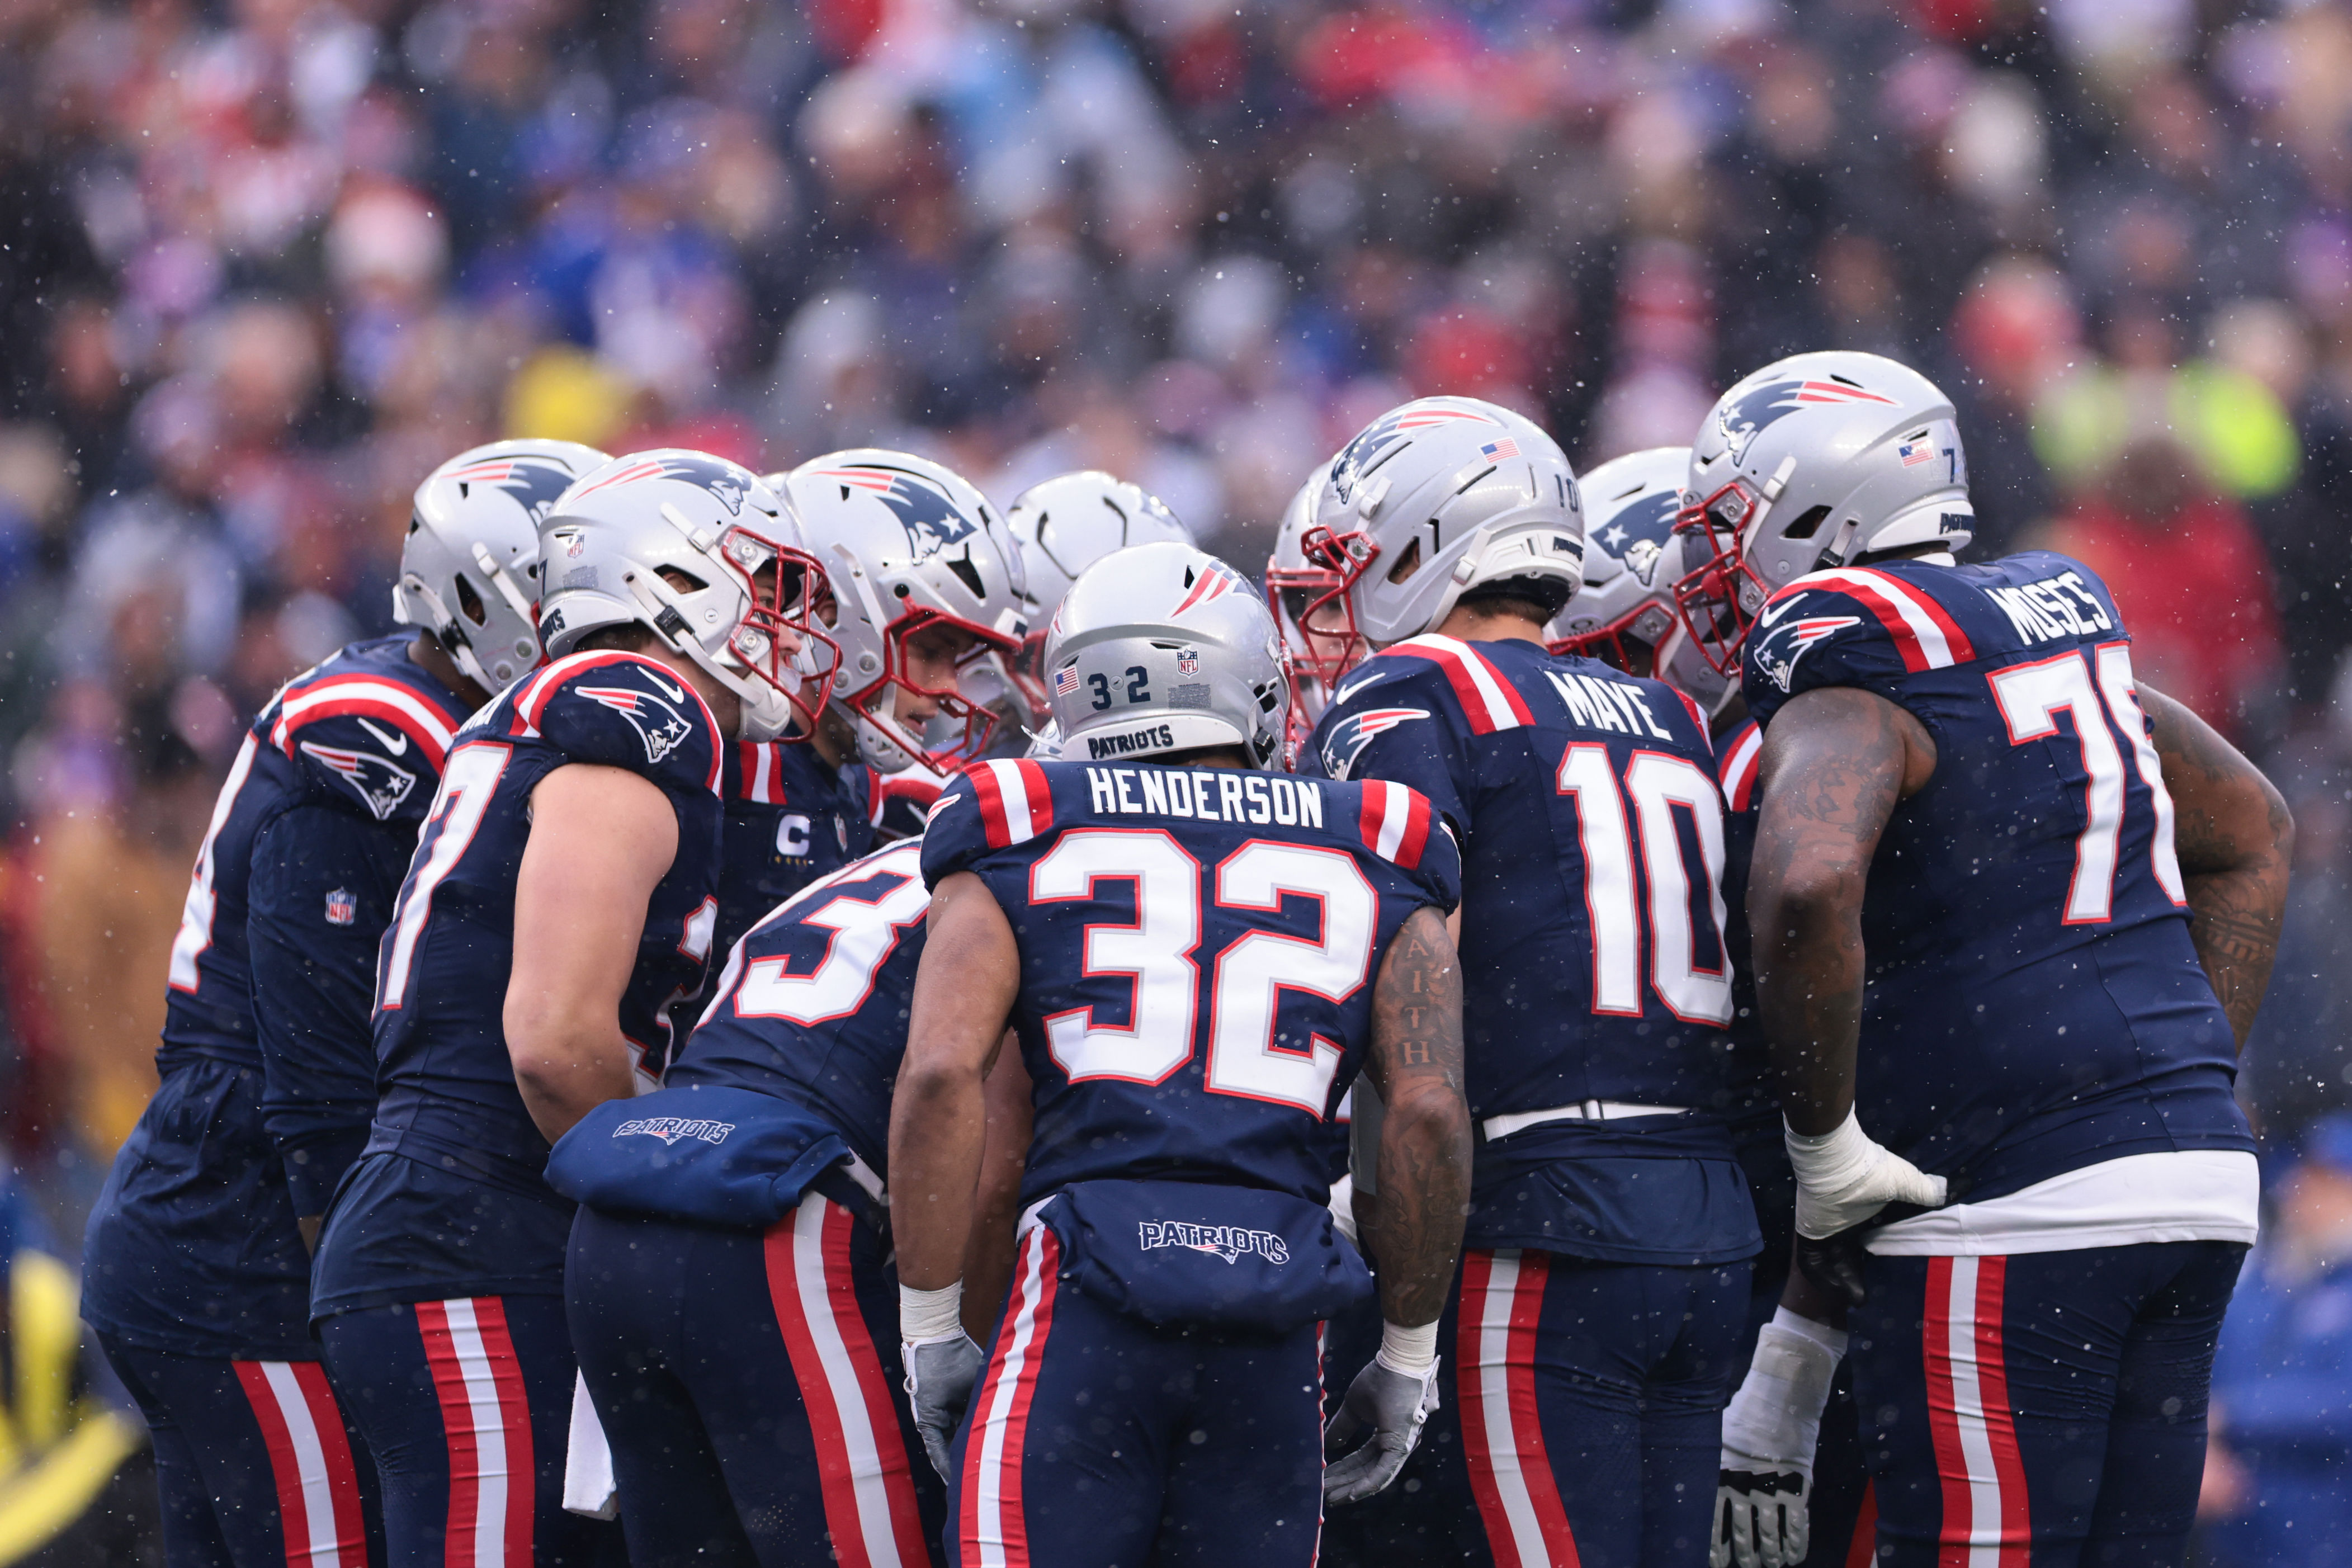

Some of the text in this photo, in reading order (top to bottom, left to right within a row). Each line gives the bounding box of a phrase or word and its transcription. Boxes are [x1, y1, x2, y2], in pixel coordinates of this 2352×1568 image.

[1555, 474, 1578, 512] 10
[1986, 570, 2112, 645] MOSES
[1179, 660, 1198, 672] NFL
[1544, 670, 1673, 742] MAYE
[1088, 724, 1174, 760] PATRIOTS
[1087, 767, 1323, 828] HENDERSON
[776, 814, 810, 856] C
[371, 740, 514, 1022] 7
[1555, 742, 1734, 1030] 10
[329, 902, 352, 922] NFL
[687, 847, 932, 1044] 3
[1028, 827, 1378, 1123] 32
[1399, 923, 1432, 1066] AITH
[612, 1117, 736, 1145] PATRIOTS
[1139, 1221, 1290, 1265] PATRIOTS
